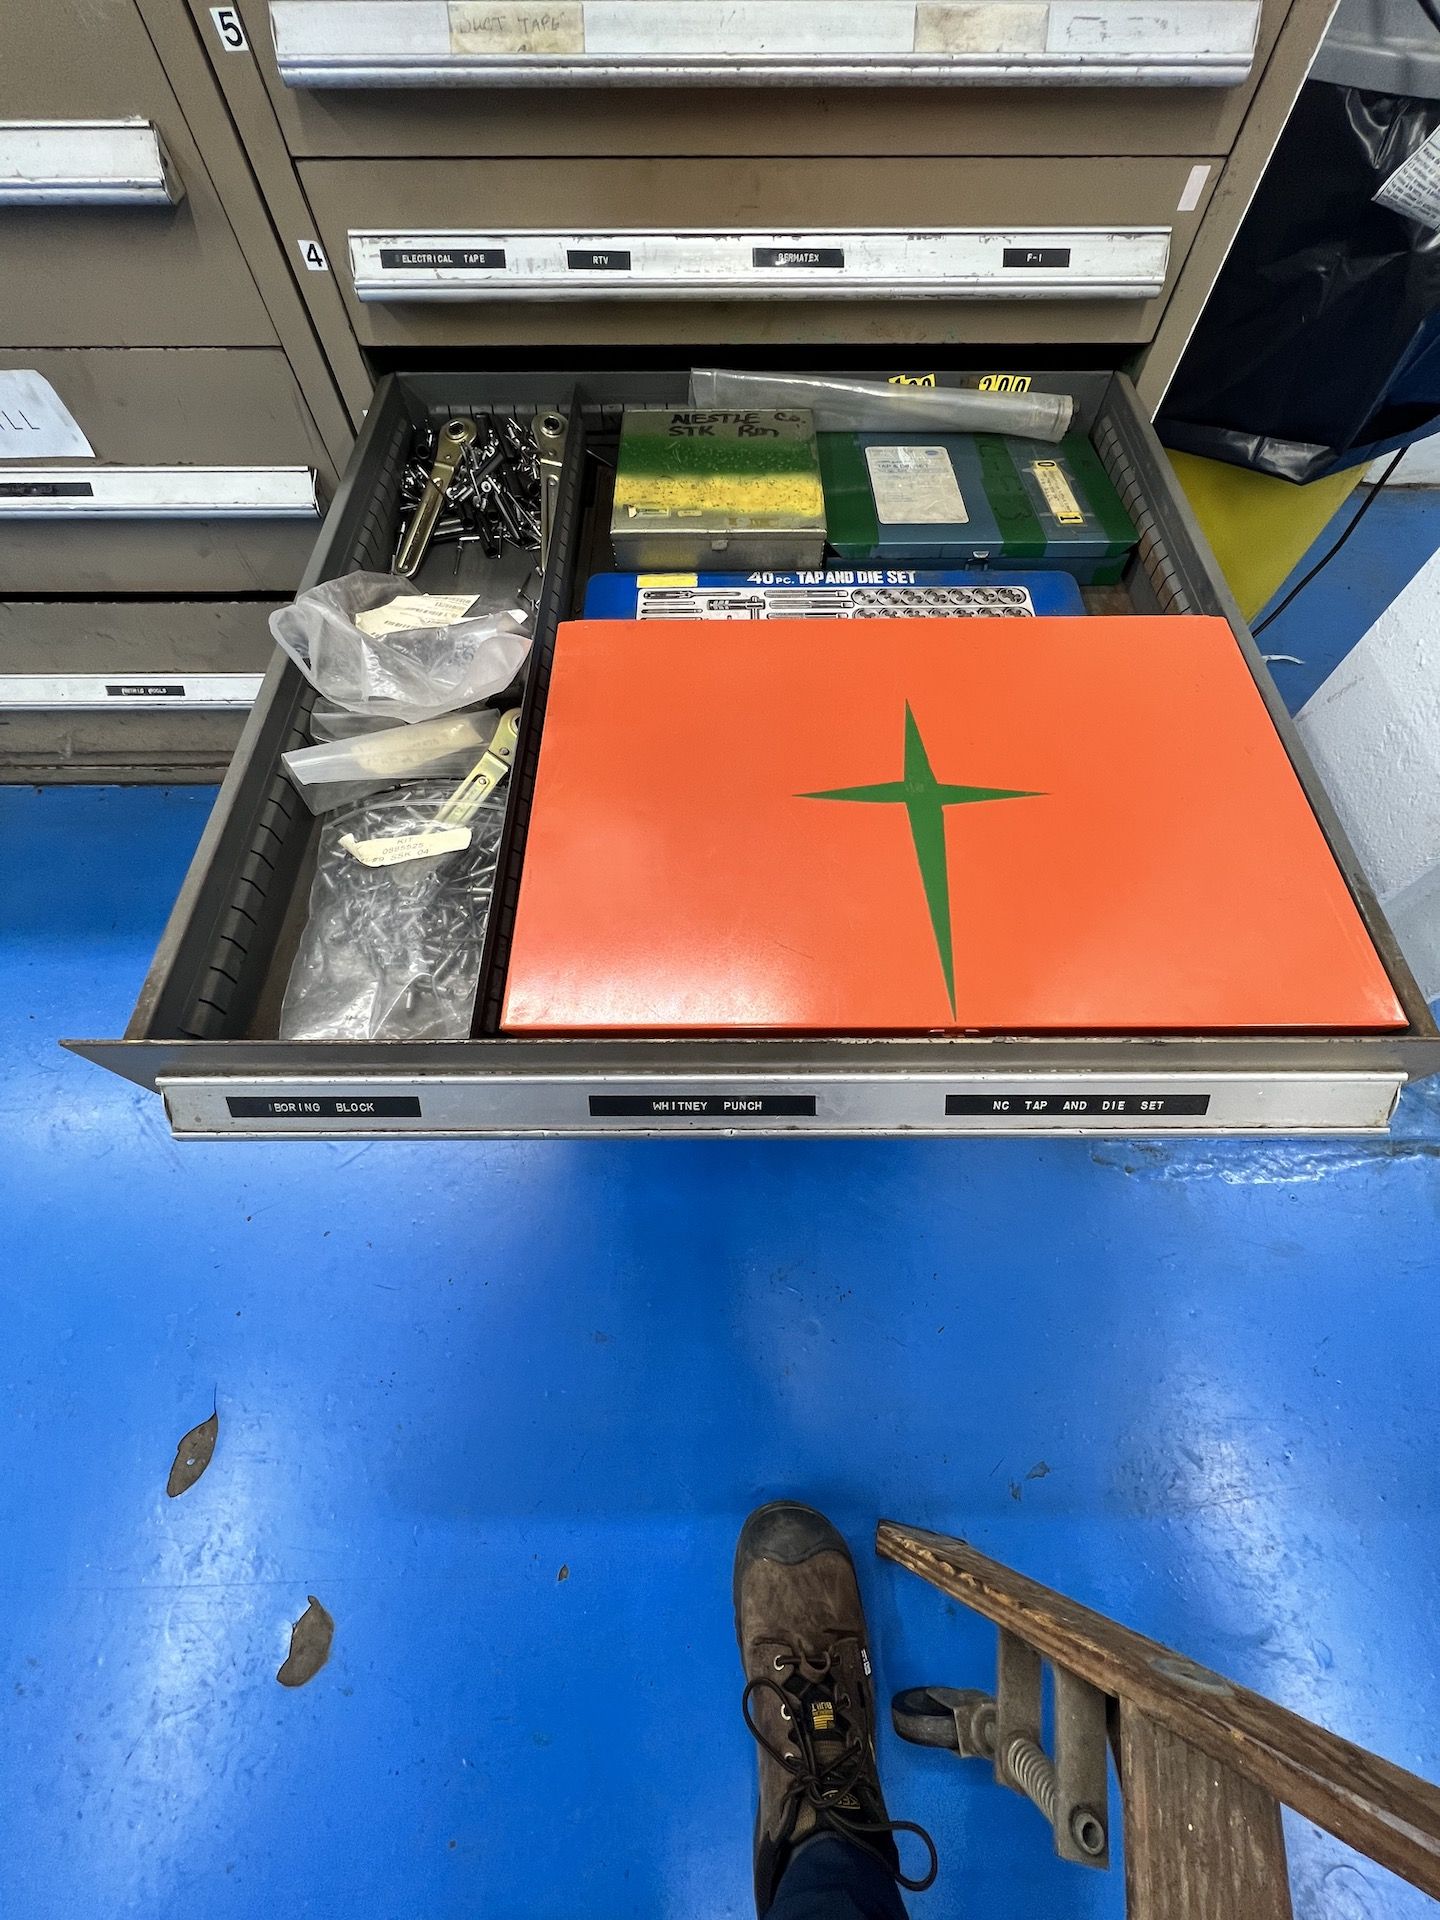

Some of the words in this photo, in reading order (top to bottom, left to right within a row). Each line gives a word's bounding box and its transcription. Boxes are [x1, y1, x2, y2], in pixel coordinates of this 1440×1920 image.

[218, 11, 243, 47] 5
[306, 244, 323, 267] 4
[401, 254, 454, 264] ELECTRICAL
[463, 254, 486, 264] TAPE
[592, 255, 609, 265] RTV
[671, 412, 760, 425] NESTLE
[668, 425, 715, 437] STK
[746, 571, 774, 585] 40
[775, 577, 795, 585] PC.
[796, 571, 824, 584] TAP
[825, 571, 854, 584] AND
[856, 571, 884, 584] DIE
[886, 570, 916, 584] SET
[397, 836, 414, 845] KIT
[273, 1102, 321, 1113] BORING
[335, 1102, 375, 1113] BLOCK
[652, 1101, 708, 1111] WHITNEY
[723, 1101, 763, 1111] PUNCH
[992, 1100, 1010, 1111] NC
[1024, 1100, 1048, 1111] TAP
[1062, 1100, 1088, 1111] AND
[1101, 1100, 1126, 1111] DIE
[1140, 1100, 1165, 1111] SET
